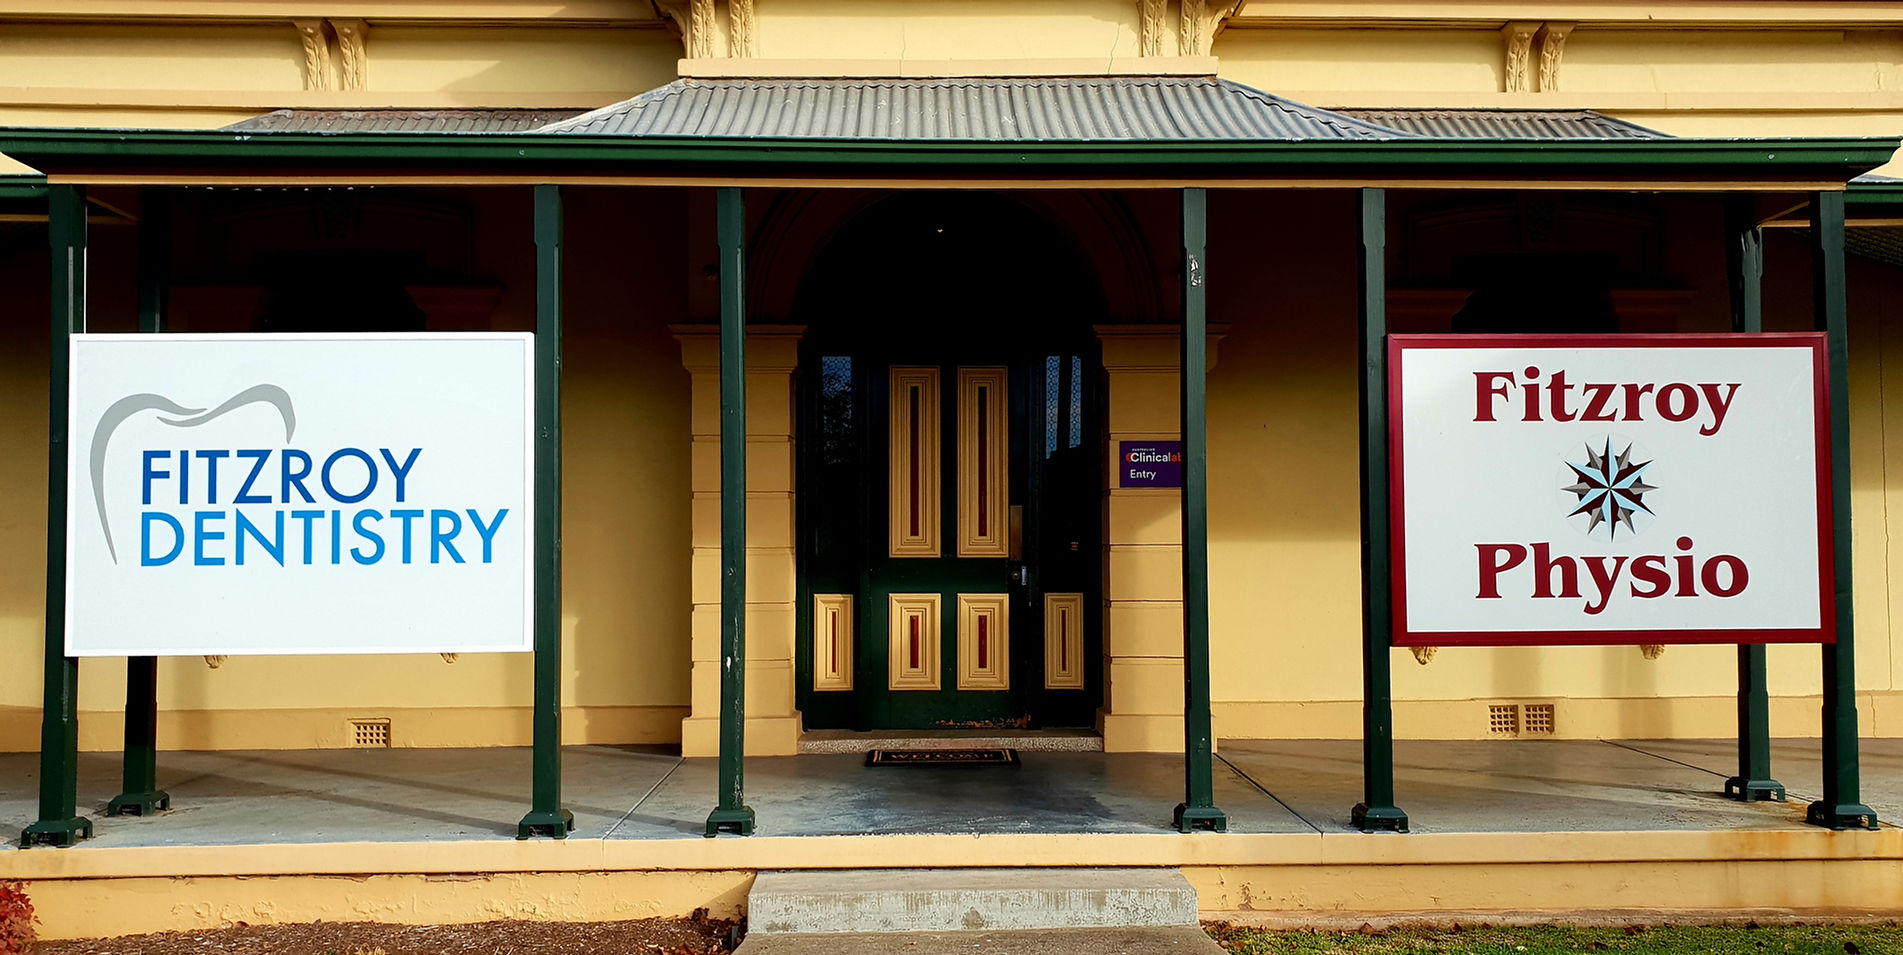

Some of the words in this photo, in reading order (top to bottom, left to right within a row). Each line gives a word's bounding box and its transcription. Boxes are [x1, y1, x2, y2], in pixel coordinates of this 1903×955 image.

[1473, 366, 1742, 437] Fitzroy
[142, 448, 422, 505] FITZROY
[1130, 469, 1156, 480] Entry
[140, 508, 509, 568] DENTISTRY
[1474, 536, 1749, 615] Physio
